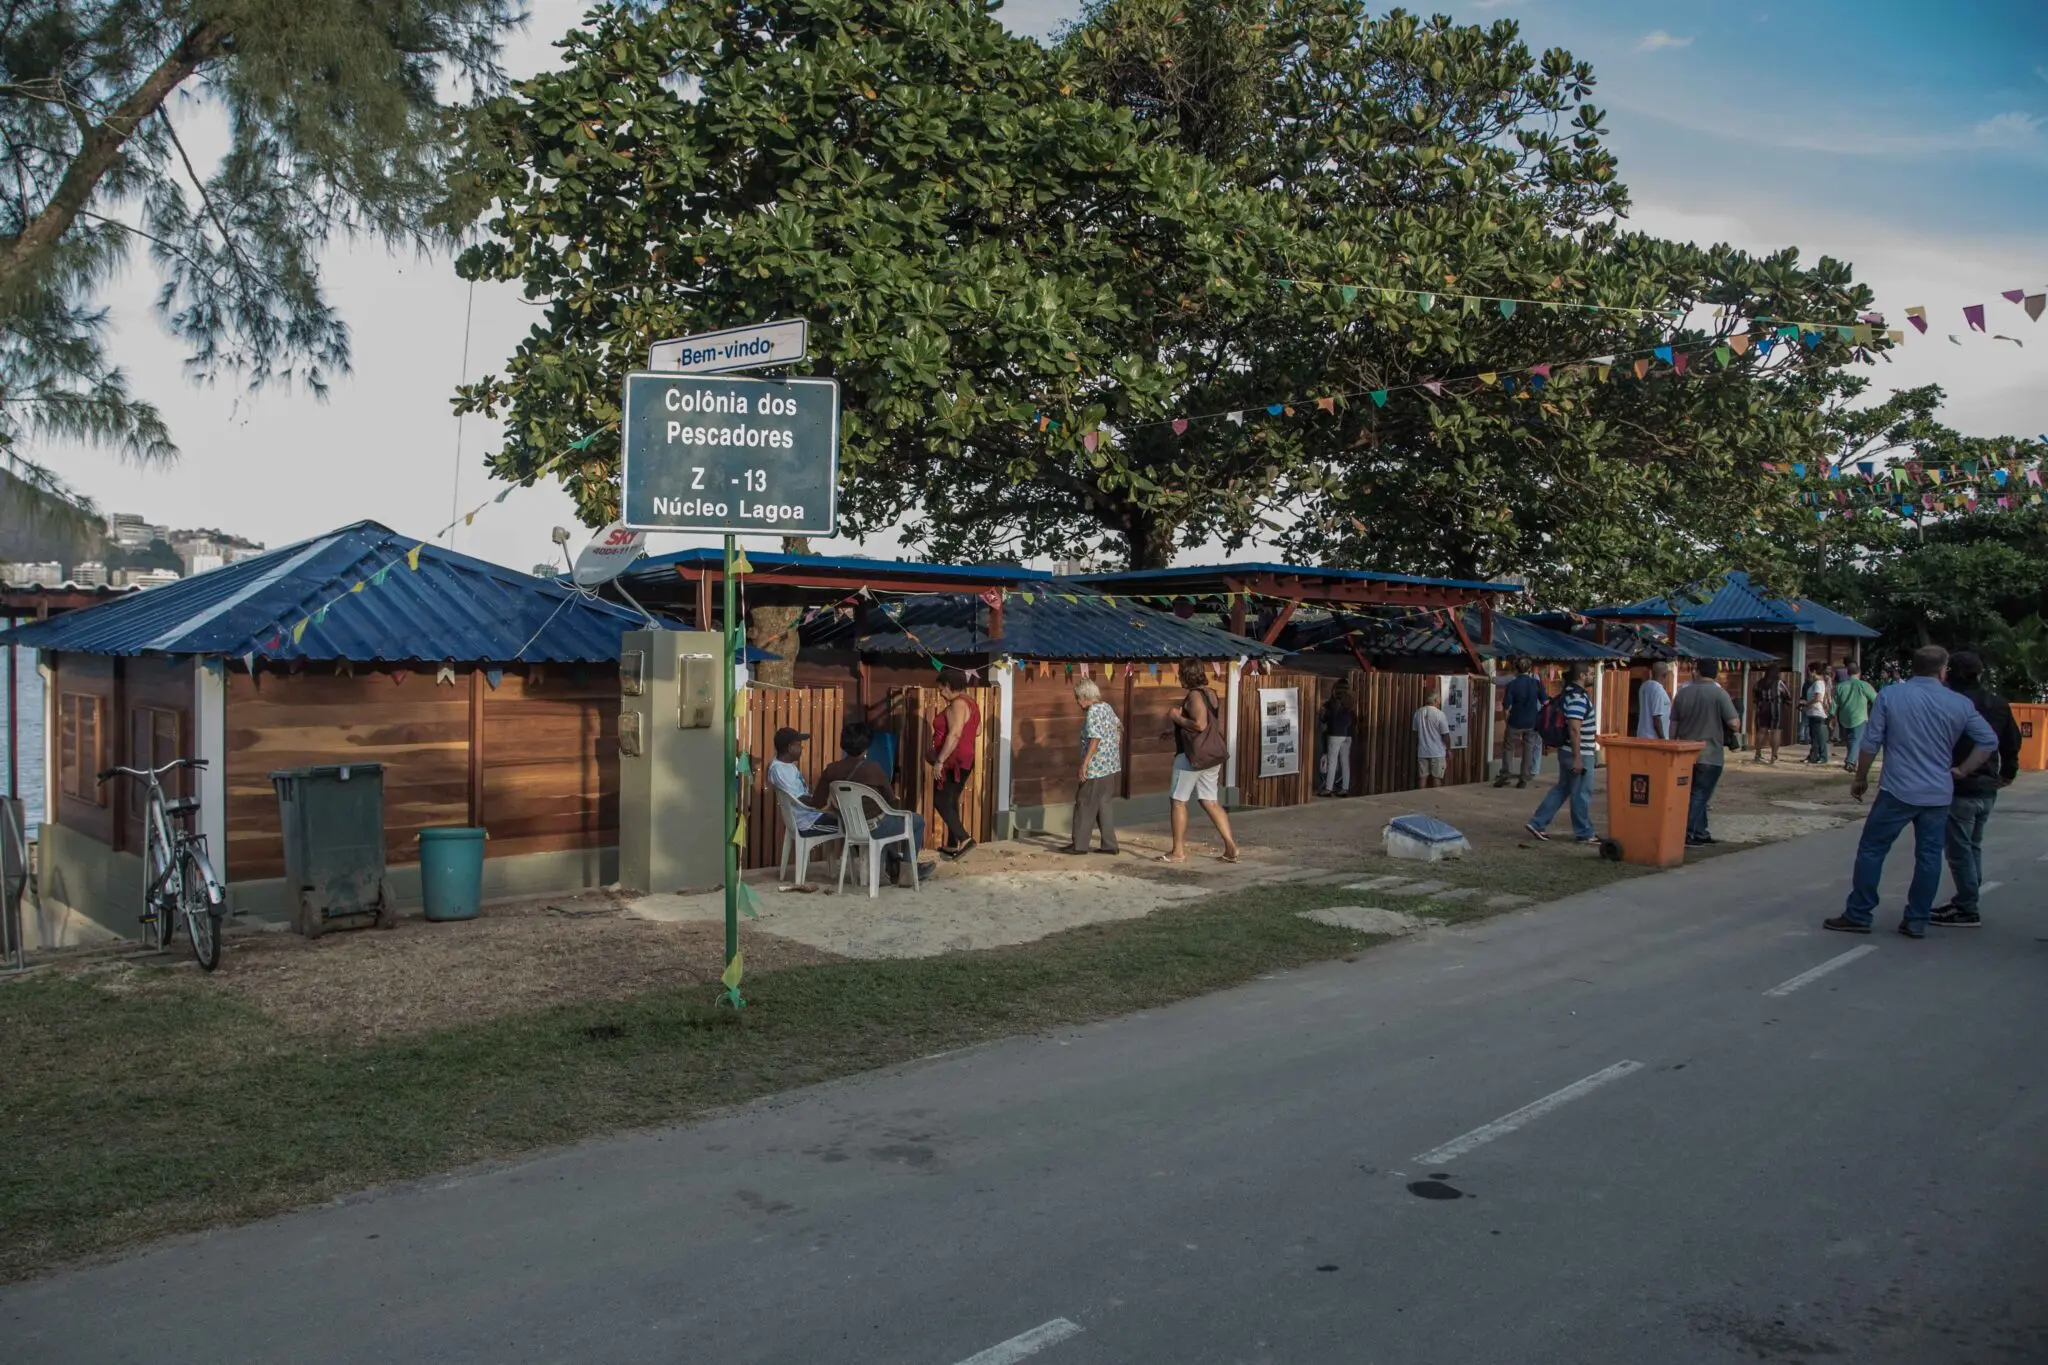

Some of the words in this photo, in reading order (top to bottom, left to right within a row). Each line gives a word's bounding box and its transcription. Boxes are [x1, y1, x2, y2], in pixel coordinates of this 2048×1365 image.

[681, 337, 771, 367] Bem-vindo
[665, 388, 748, 414] Colônia
[757, 393, 797, 416] dos
[667, 421, 794, 448] Pescadores
[691, 467, 705, 490] Z
[653, 497, 728, 517] Núcleo
[740, 500, 804, 522] Lagoa
